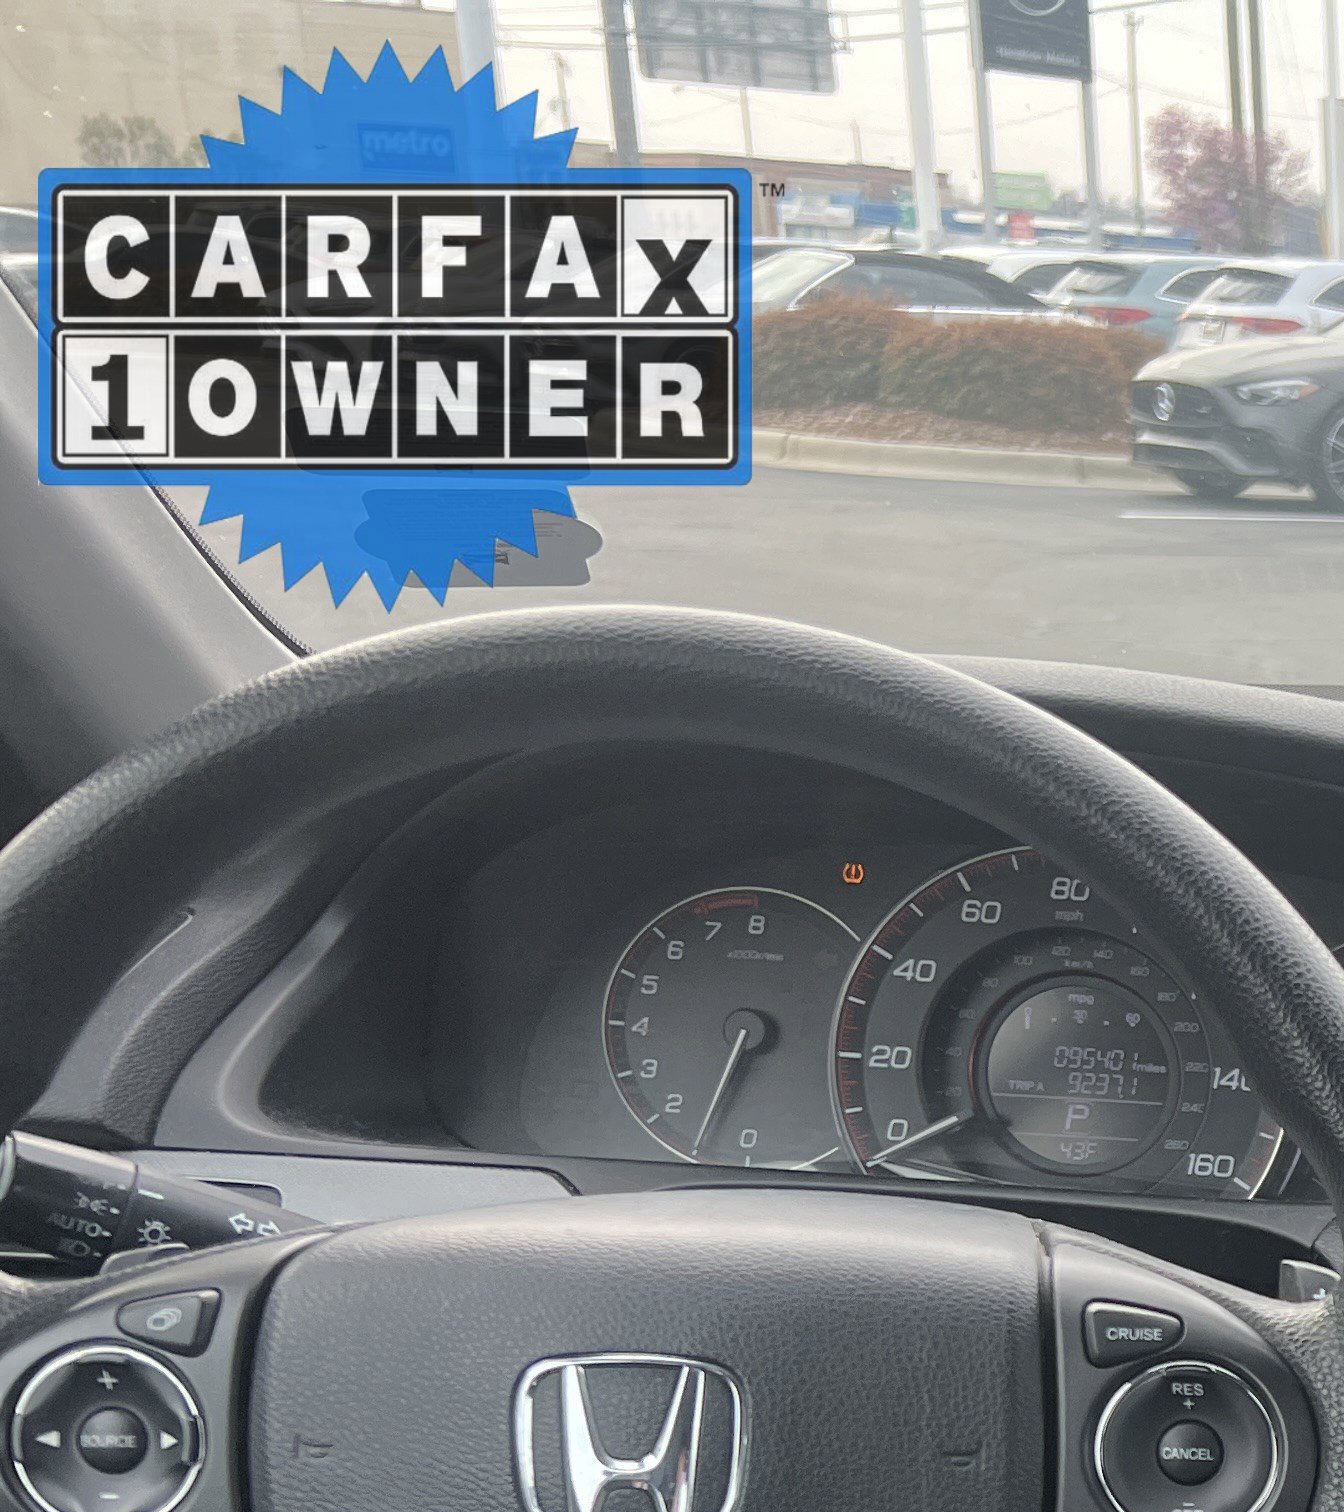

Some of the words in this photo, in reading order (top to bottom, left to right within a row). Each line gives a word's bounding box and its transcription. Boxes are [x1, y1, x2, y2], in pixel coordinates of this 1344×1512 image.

[961, 899, 1001, 924] 60
[1055, 910, 1084, 922] mph
[705, 921, 722, 941] 7
[748, 914, 765, 935] 8
[667, 940, 685, 960] 6
[893, 959, 937, 983] 40
[640, 974, 660, 995] 5
[631, 1016, 650, 1037] 4
[869, 1045, 912, 1070] 20
[640, 1059, 658, 1079] 3
[1136, 1062, 1167, 1074] miles
[1008, 1079, 1035, 1091] TRIP
[665, 1093, 683, 1113] 2
[1064, 1103, 1090, 1131] P
[739, 1128, 758, 1149] 0
[887, 1119, 909, 1142] 0
[1186, 1152, 1236, 1178] 160
[1105, 1327, 1164, 1342] CRUISE
[1171, 1381, 1205, 1397] RES
[80, 1434, 136, 1449] SOURCE
[1161, 1446, 1215, 1461] CANCEL
